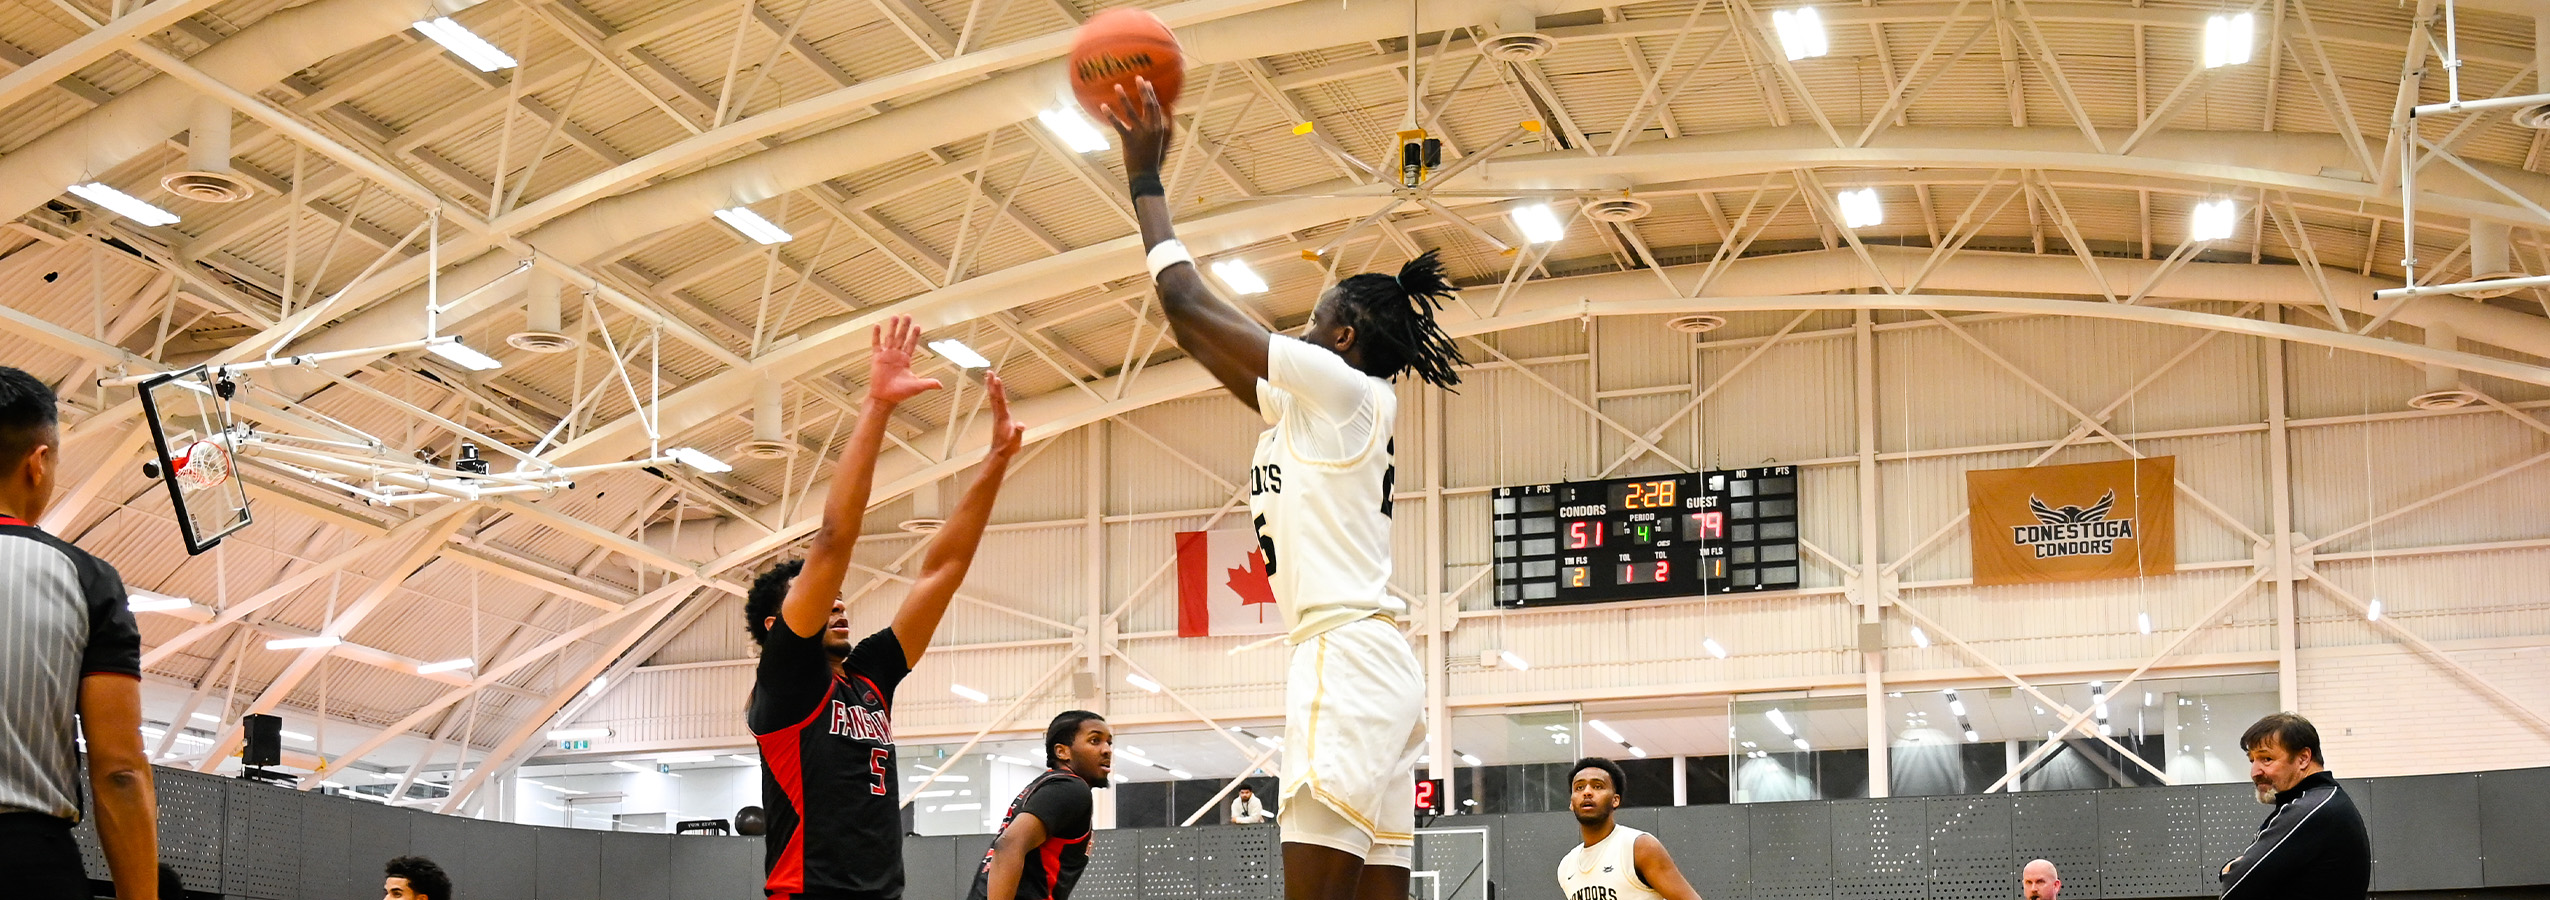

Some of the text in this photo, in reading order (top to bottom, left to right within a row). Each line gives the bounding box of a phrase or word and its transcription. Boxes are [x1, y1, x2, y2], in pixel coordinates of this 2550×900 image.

[1735, 466, 1790, 479] NO F PTS
[1499, 484, 1551, 497] NO F PTS
[1625, 480, 1676, 509] 2:28
[1559, 504, 1606, 518] CONDORS
[1686, 496, 1718, 509] GUEST
[1629, 512, 1655, 522] PERIOD
[1691, 511, 1723, 538] 79
[1571, 521, 1604, 549] 51
[1637, 525, 1648, 542] 4
[2014, 519, 2132, 544] CONESTOGA
[1618, 553, 1631, 562] TOL
[1654, 550, 1668, 559] TOL
[1710, 546, 1724, 555] FLS
[2035, 539, 2112, 558] CONDORS
[1575, 555, 1588, 565] FLS
[1715, 559, 1721, 577] 1
[1572, 566, 1585, 588] 2
[1626, 563, 1634, 583] 1
[1654, 560, 1669, 583] 2
[869, 747, 889, 796] 5
[1416, 780, 1434, 809] 2
